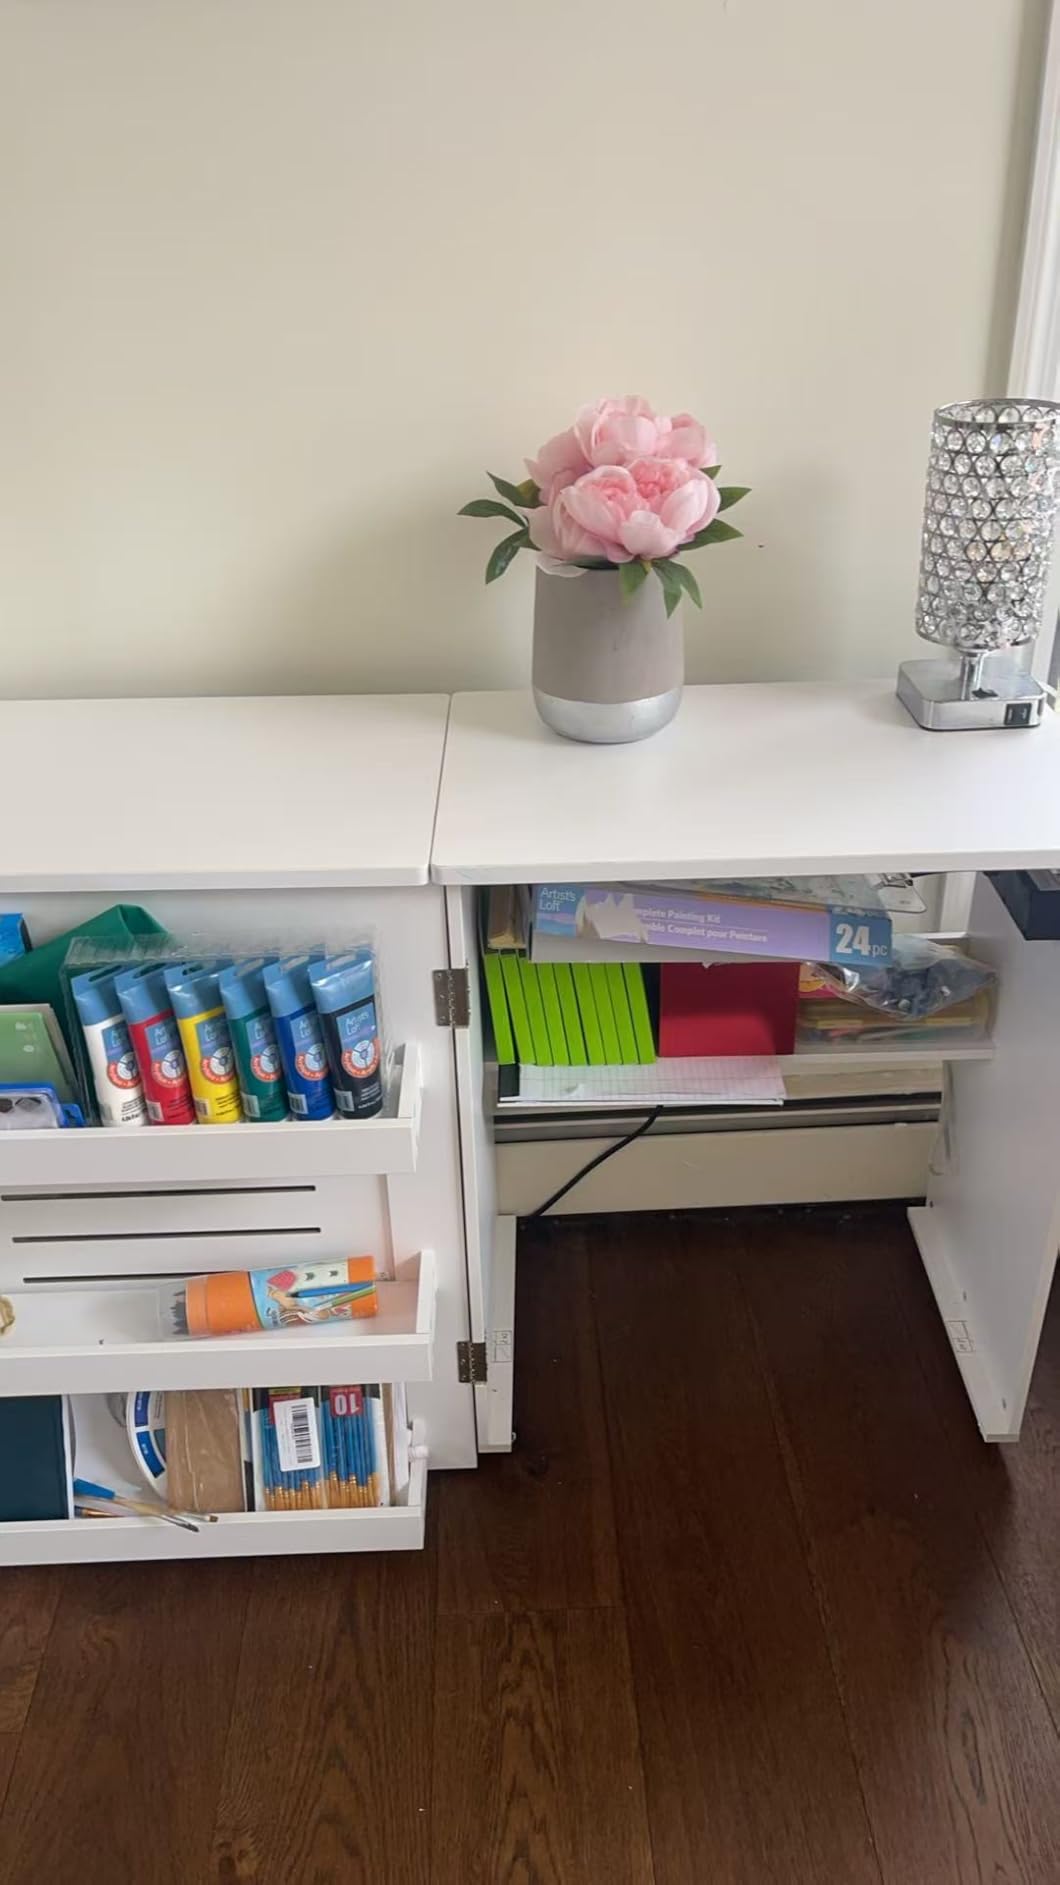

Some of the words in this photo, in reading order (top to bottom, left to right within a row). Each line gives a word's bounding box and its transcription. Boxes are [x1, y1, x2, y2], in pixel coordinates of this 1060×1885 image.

[540, 888, 576, 902] Artist's
[539, 900, 560, 912] Loft
[668, 910, 705, 923] Painting
[707, 914, 720, 923] Kit
[836, 923, 870, 956] 24
[872, 944, 888, 957] pc
[334, 1393, 360, 1415] 10
